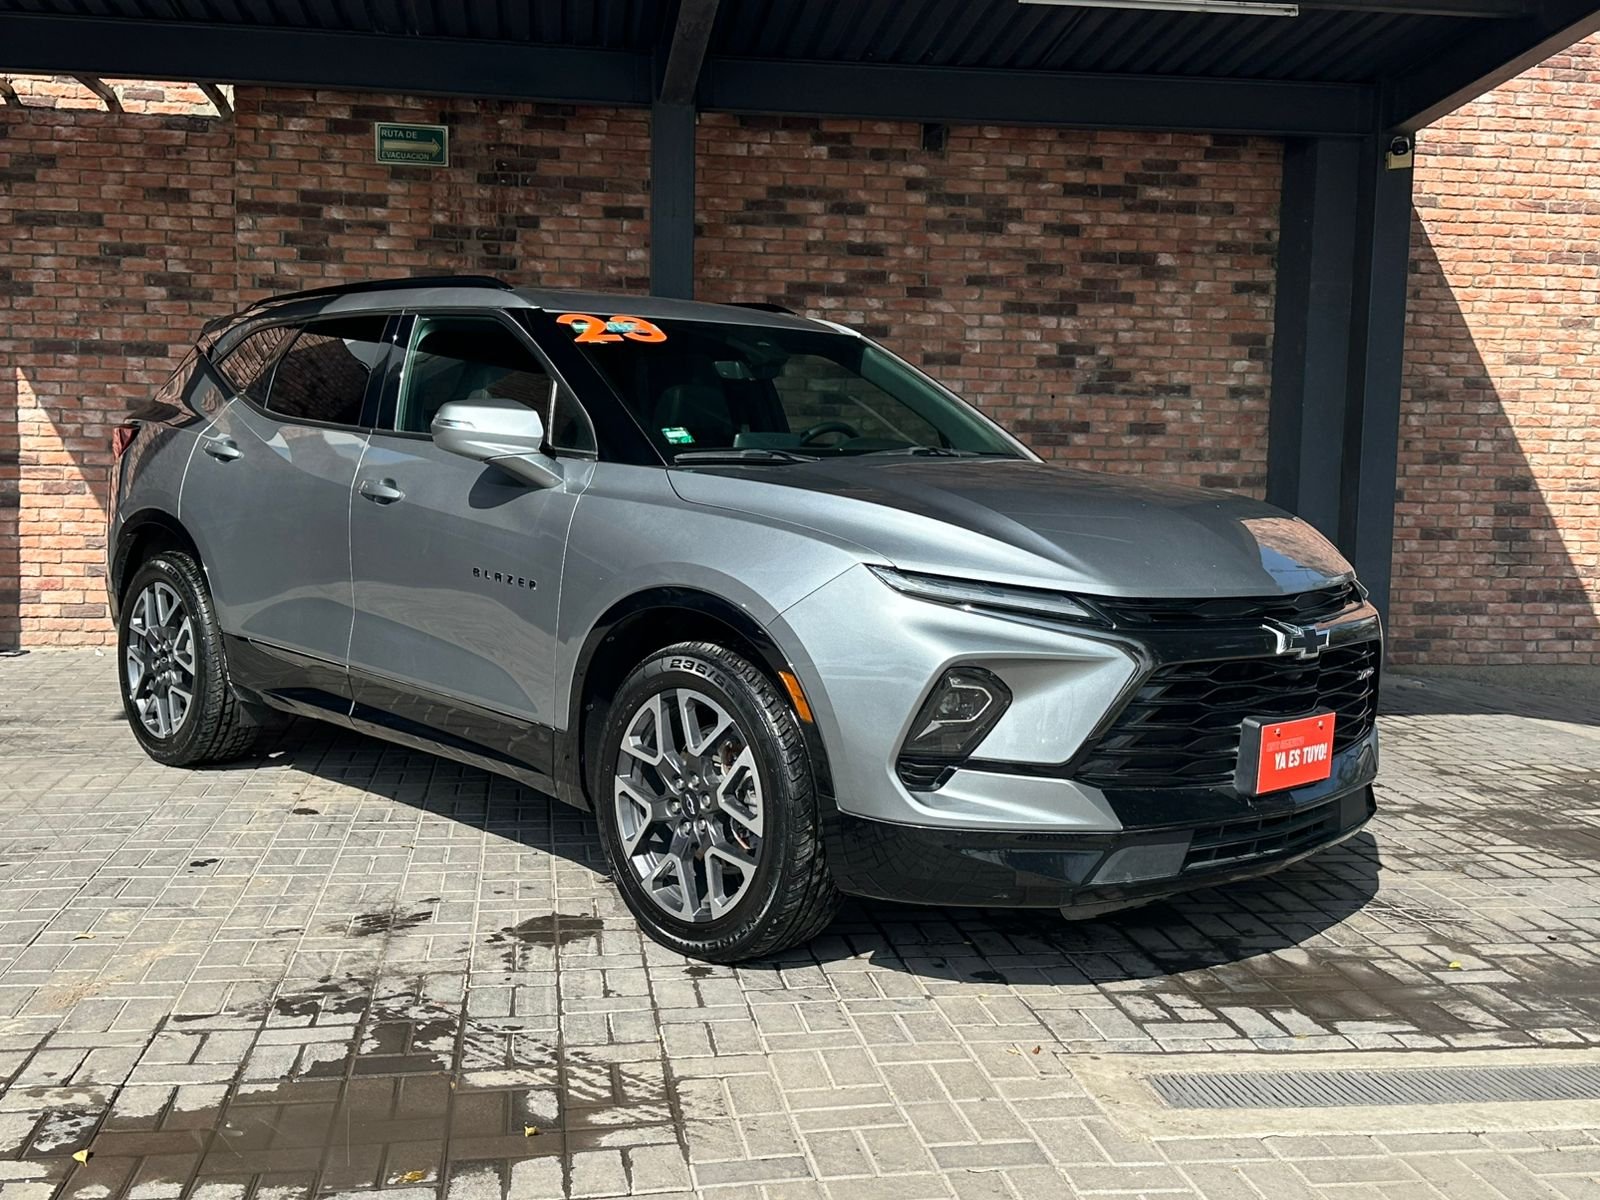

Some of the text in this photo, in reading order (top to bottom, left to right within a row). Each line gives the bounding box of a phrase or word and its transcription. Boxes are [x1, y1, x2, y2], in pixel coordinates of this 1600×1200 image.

[381, 129, 417, 139] RUTA DE
[556, 313, 667, 344] 23
[472, 566, 537, 592] BLAZER
[1274, 751, 1287, 771] YA
[1287, 748, 1301, 769] ES
[1302, 742, 1328, 765] TUYO!
